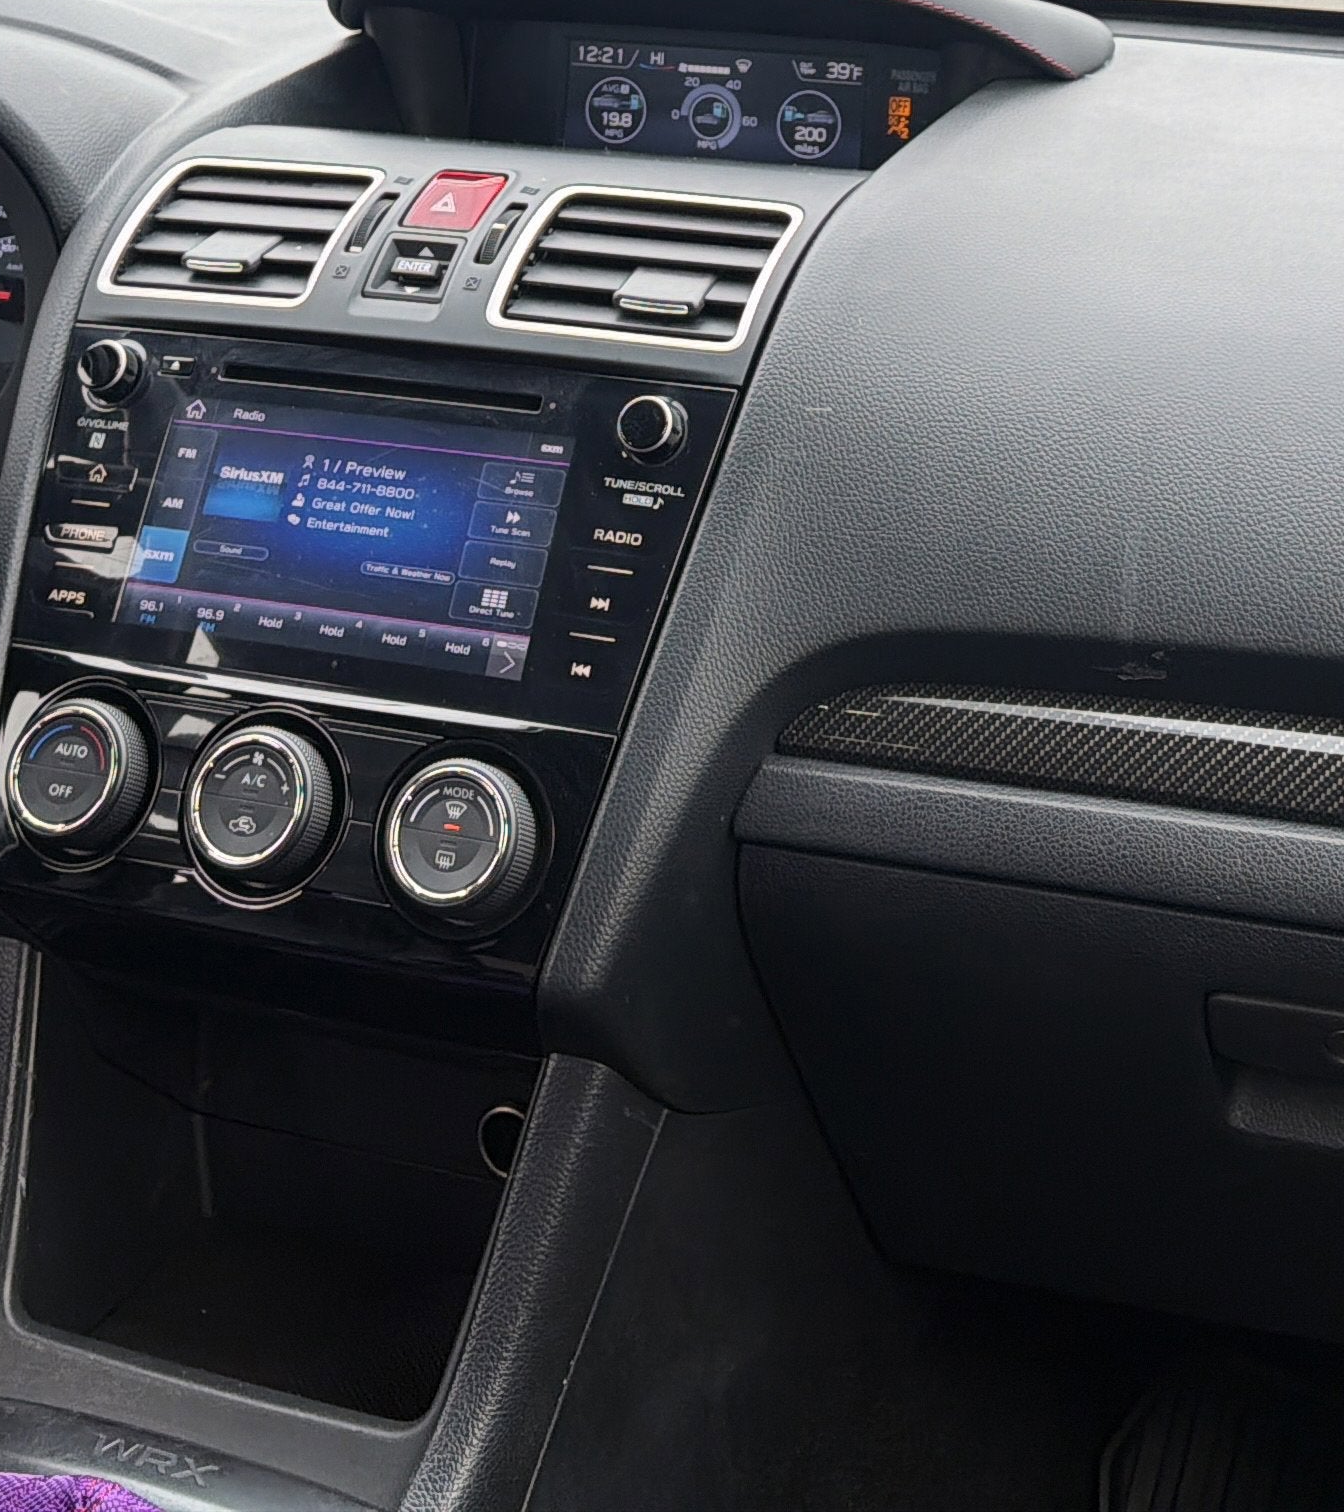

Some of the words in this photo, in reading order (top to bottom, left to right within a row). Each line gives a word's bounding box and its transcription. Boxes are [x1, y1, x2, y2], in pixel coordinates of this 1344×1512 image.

[578, 45, 624, 64] 12:21
[684, 76, 701, 87] 20
[725, 79, 743, 90] 40
[742, 116, 758, 127] 60
[794, 125, 827, 143] 200
[397, 260, 433, 273] ENTER
[233, 406, 266, 422] Radio
[177, 447, 197, 459] FM
[219, 465, 284, 485] SiriusXM
[322, 459, 330, 472] 1
[345, 461, 408, 481] Preview
[316, 477, 416, 500] 844-711-8800
[604, 477, 685, 498] TUNE/SCROLL
[162, 496, 184, 510] AM
[312, 497, 346, 513] Great
[349, 501, 381, 518] Offer
[60, 526, 107, 542] PHONE
[306, 516, 391, 538] Entertainment
[593, 528, 643, 547] RADIO
[144, 549, 174, 563] sxm
[47, 588, 86, 605] APPS
[139, 598, 164, 613] 96.1
[196, 606, 225, 621] 96.9
[258, 615, 284, 629] Hold
[319, 624, 345, 638] Hold
[381, 632, 408, 647] Hold
[444, 641, 471, 656] Hold
[54, 742, 89, 759] AUTO
[240, 772, 268, 788] A/C
[48, 783, 74, 798] OFF
[442, 786, 475, 801] MODE
[94, 1432, 221, 1488] WRX
